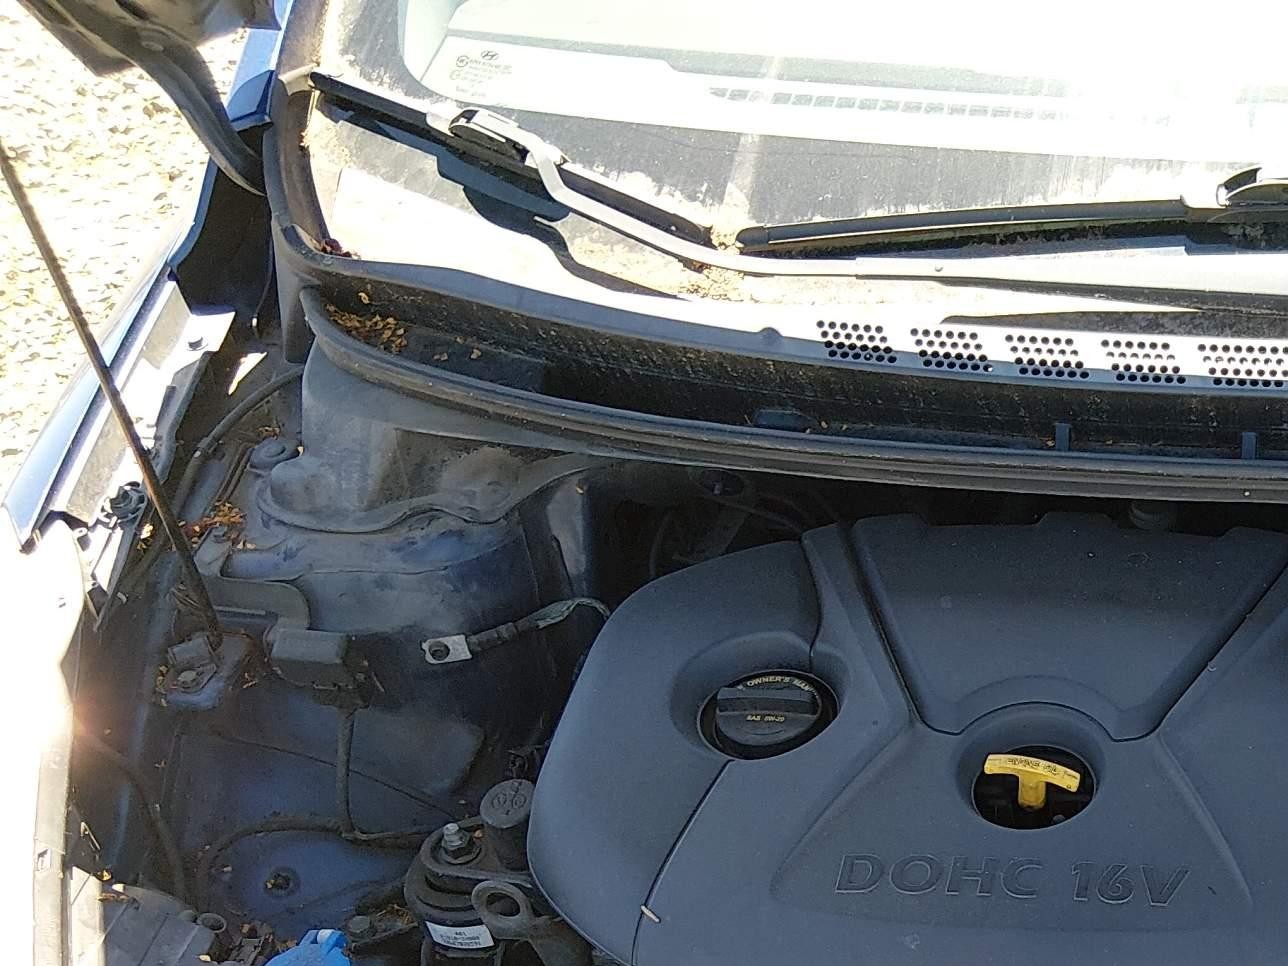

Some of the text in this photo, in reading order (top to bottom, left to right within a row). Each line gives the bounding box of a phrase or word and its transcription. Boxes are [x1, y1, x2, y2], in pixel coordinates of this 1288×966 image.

[746, 675, 791, 687] OWNER'S
[834, 852, 1191, 908] DOHC 16V
